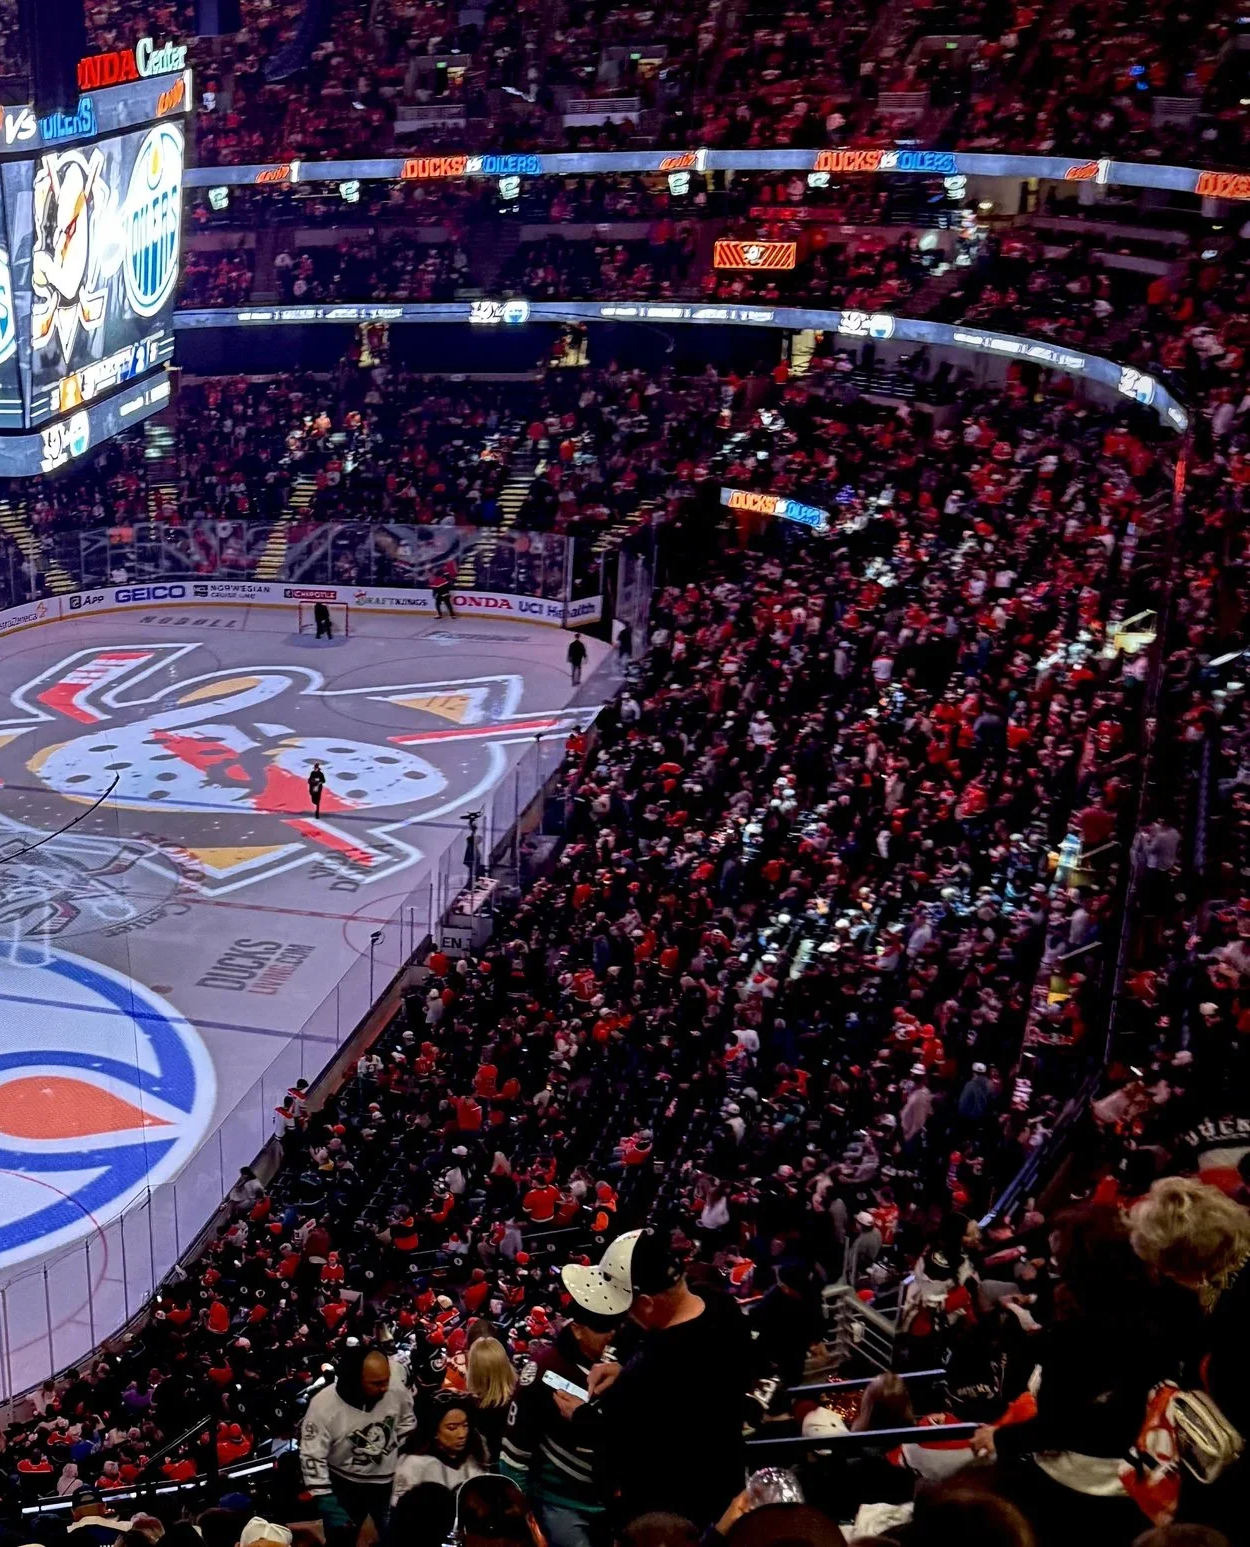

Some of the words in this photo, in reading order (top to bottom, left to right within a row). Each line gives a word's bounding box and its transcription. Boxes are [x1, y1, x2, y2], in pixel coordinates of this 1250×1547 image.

[78, 49, 139, 89] NDA
[136, 38, 187, 77] Center
[403, 156, 465, 178] DUCKS
[483, 155, 541, 174] OILERS
[816, 149, 882, 171] DUCKS
[729, 491, 780, 514] DUCKS
[115, 584, 186, 603] GEICO
[210, 584, 270, 593] NORWEGIAN
[452, 595, 513, 610] ONDA
[518, 601, 544, 615] UCI
[195, 939, 283, 991] DUCKS
